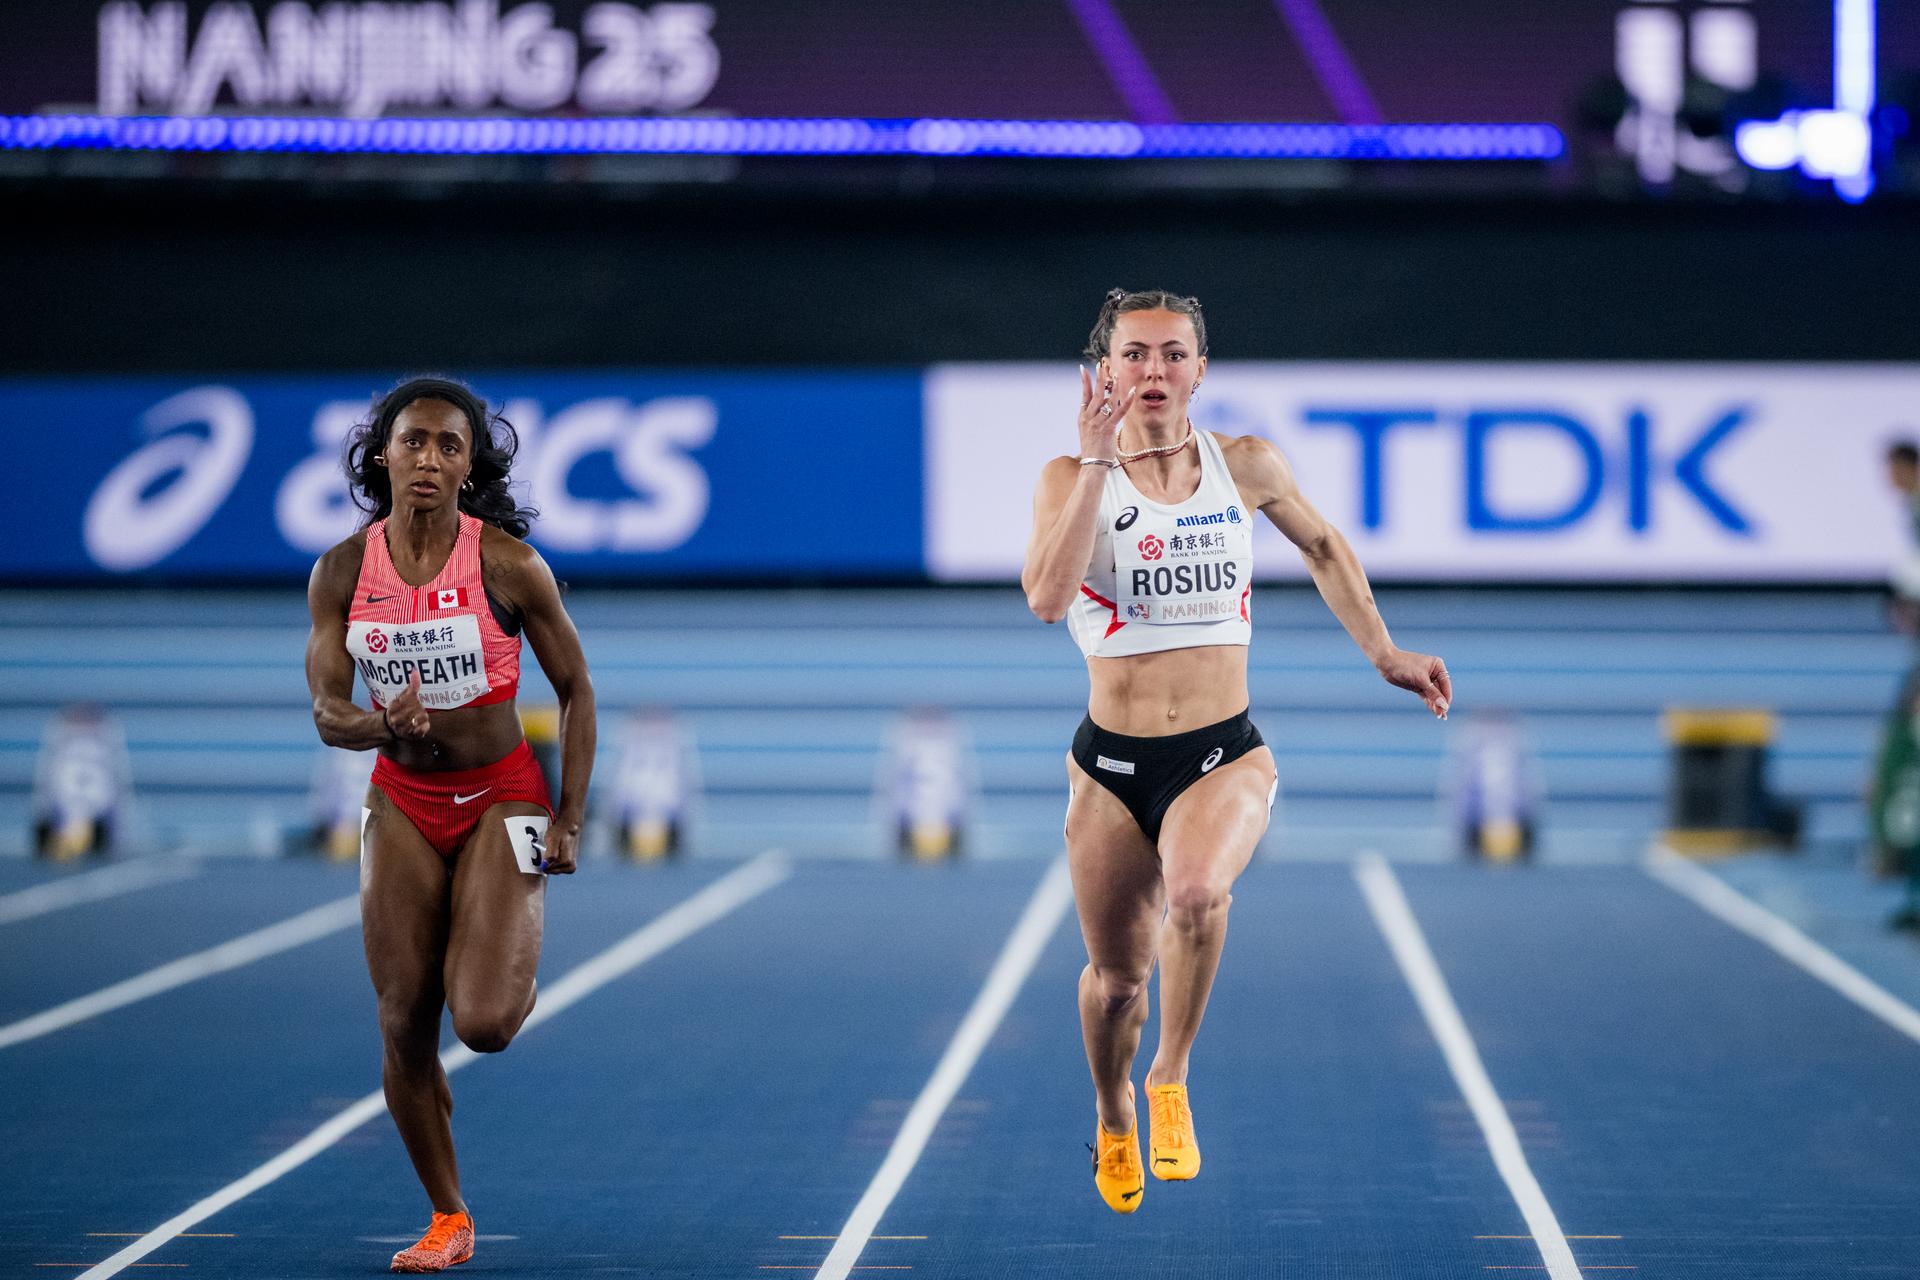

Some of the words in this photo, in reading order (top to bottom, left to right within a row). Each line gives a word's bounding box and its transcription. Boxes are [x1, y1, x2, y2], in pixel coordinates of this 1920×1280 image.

[579, 1, 720, 113] 25
[1300, 400, 1761, 537] TDK
[1176, 512, 1225, 527] Allianz
[1169, 532, 1226, 551] 南京银行
[1170, 551, 1189, 559] BANK
[1132, 561, 1237, 596] ROSIUS
[392, 626, 454, 646] 南京银行
[426, 643, 456, 652] NANJING
[463, 684, 481, 699] 25
[525, 825, 542, 867] 3
